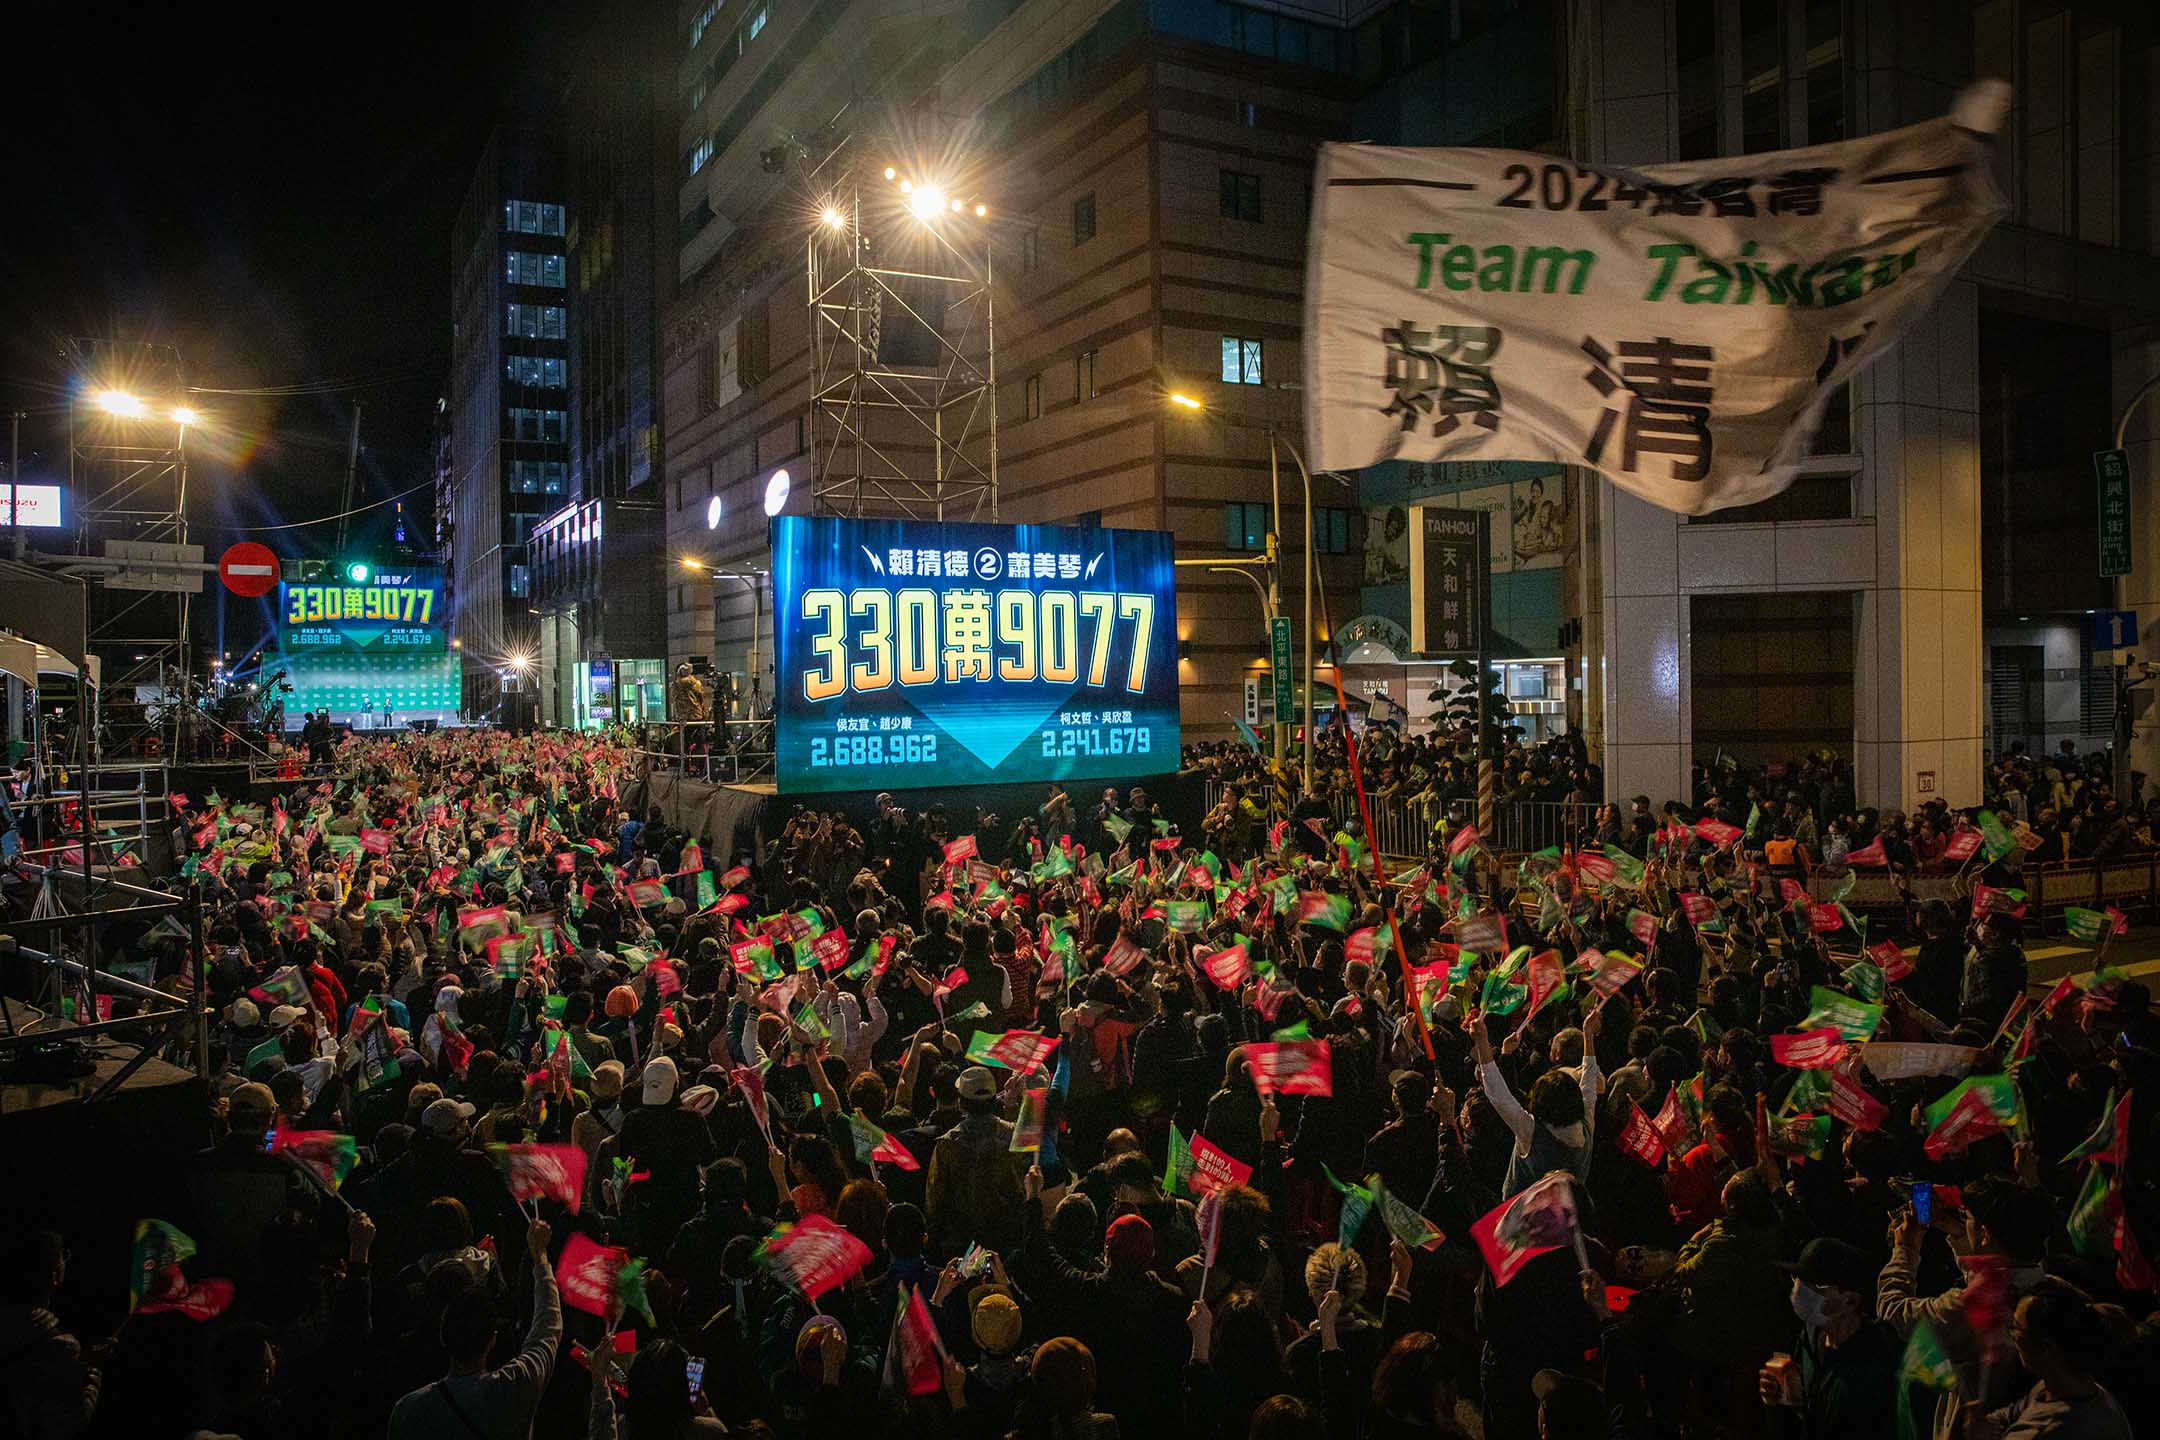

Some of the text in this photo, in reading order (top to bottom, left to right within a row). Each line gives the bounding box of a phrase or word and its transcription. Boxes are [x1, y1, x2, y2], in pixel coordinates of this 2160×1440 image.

[1407, 232, 1917, 308] Team Taiwan
[1426, 519, 1475, 535] TANHOU
[888, 548, 968, 577] 賴清德
[1008, 552, 1081, 579] 蕭美琴
[288, 587, 434, 624] 330萬9077
[1443, 547, 1458, 650] 天和鮮物
[802, 588, 1155, 702] 330萬9077
[811, 735, 937, 767] 2,688,962
[1042, 728, 1150, 758] 2,241,679
